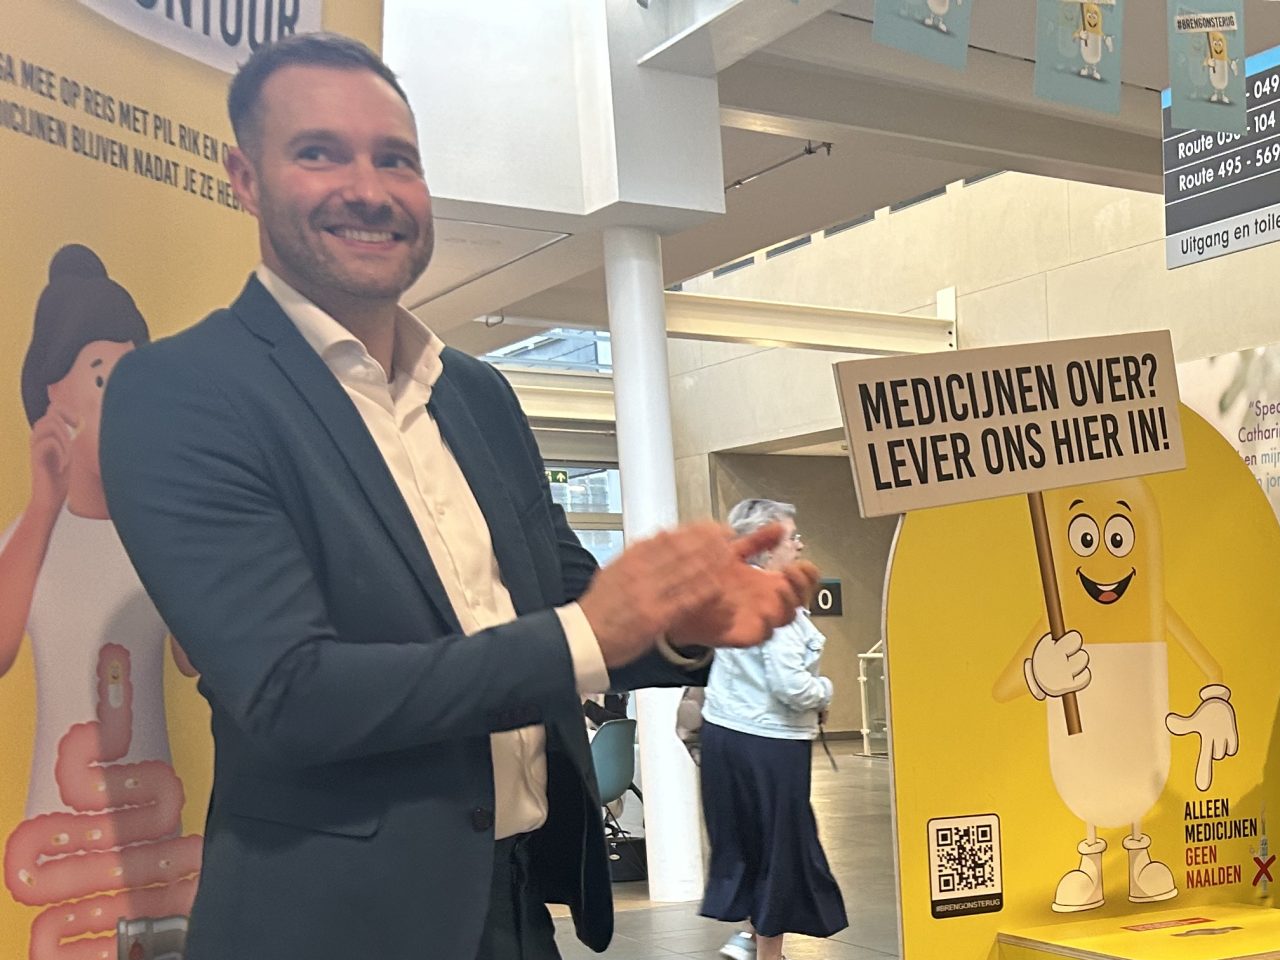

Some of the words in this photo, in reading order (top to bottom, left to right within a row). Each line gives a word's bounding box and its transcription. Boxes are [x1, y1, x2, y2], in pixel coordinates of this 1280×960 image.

[1254, 74, 1280, 99] 049
[118, 100, 148, 136] MET
[153, 113, 176, 147] PIL
[178, 123, 201, 156] RIK
[203, 133, 219, 163] EN
[1178, 134, 1214, 159] Route
[1254, 110, 1276, 133] 104
[72, 124, 129, 172] BLIJVEN
[133, 147, 180, 188] NADAT
[182, 165, 197, 195] JE
[199, 171, 214, 201] ZE
[1179, 168, 1214, 191] Route
[1218, 156, 1242, 179] 495
[1255, 143, 1280, 167] 569
[1181, 230, 1229, 255] Uitgang
[1234, 223, 1250, 240] en
[858, 364, 1059, 432] MEDICIJNEN
[1066, 353, 1158, 407] OVER?
[867, 432, 976, 491] LEVER
[981, 422, 1046, 475] ONS
[1051, 413, 1124, 465] HIER
[1128, 406, 1170, 454] IN!
[1184, 798, 1229, 821] ALLEEN
[1184, 818, 1257, 843] MEDICIJNEN
[1185, 847, 1217, 867] GEEN
[1186, 869, 1242, 889] NAALDEN
[935, 898, 1000, 913] #BRENGONSTERUG
